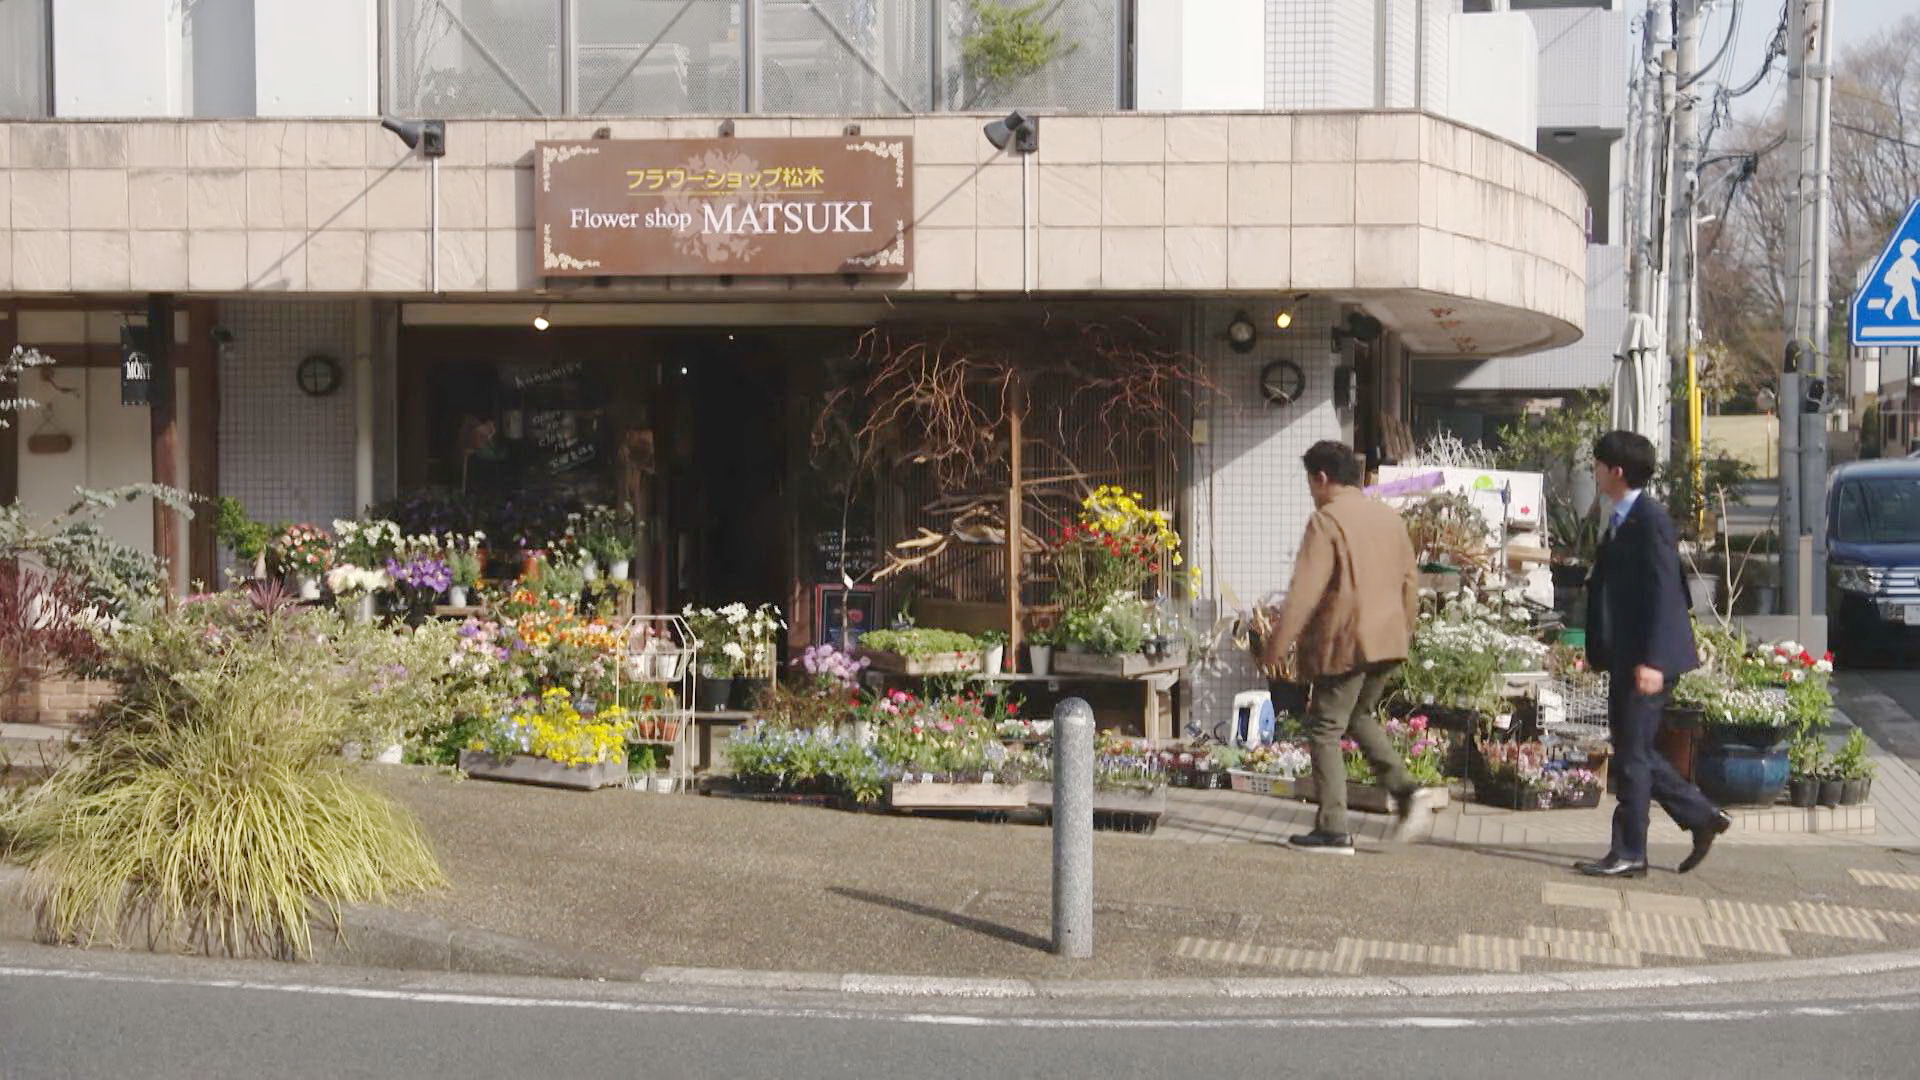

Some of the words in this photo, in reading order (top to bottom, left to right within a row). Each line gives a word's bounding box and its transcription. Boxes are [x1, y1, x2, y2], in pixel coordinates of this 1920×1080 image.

[626, 167, 824, 189] フラワーショップ松木
[570, 208, 639, 228] Flower
[645, 208, 692, 231] shop
[701, 201, 873, 234] MATSUKI
